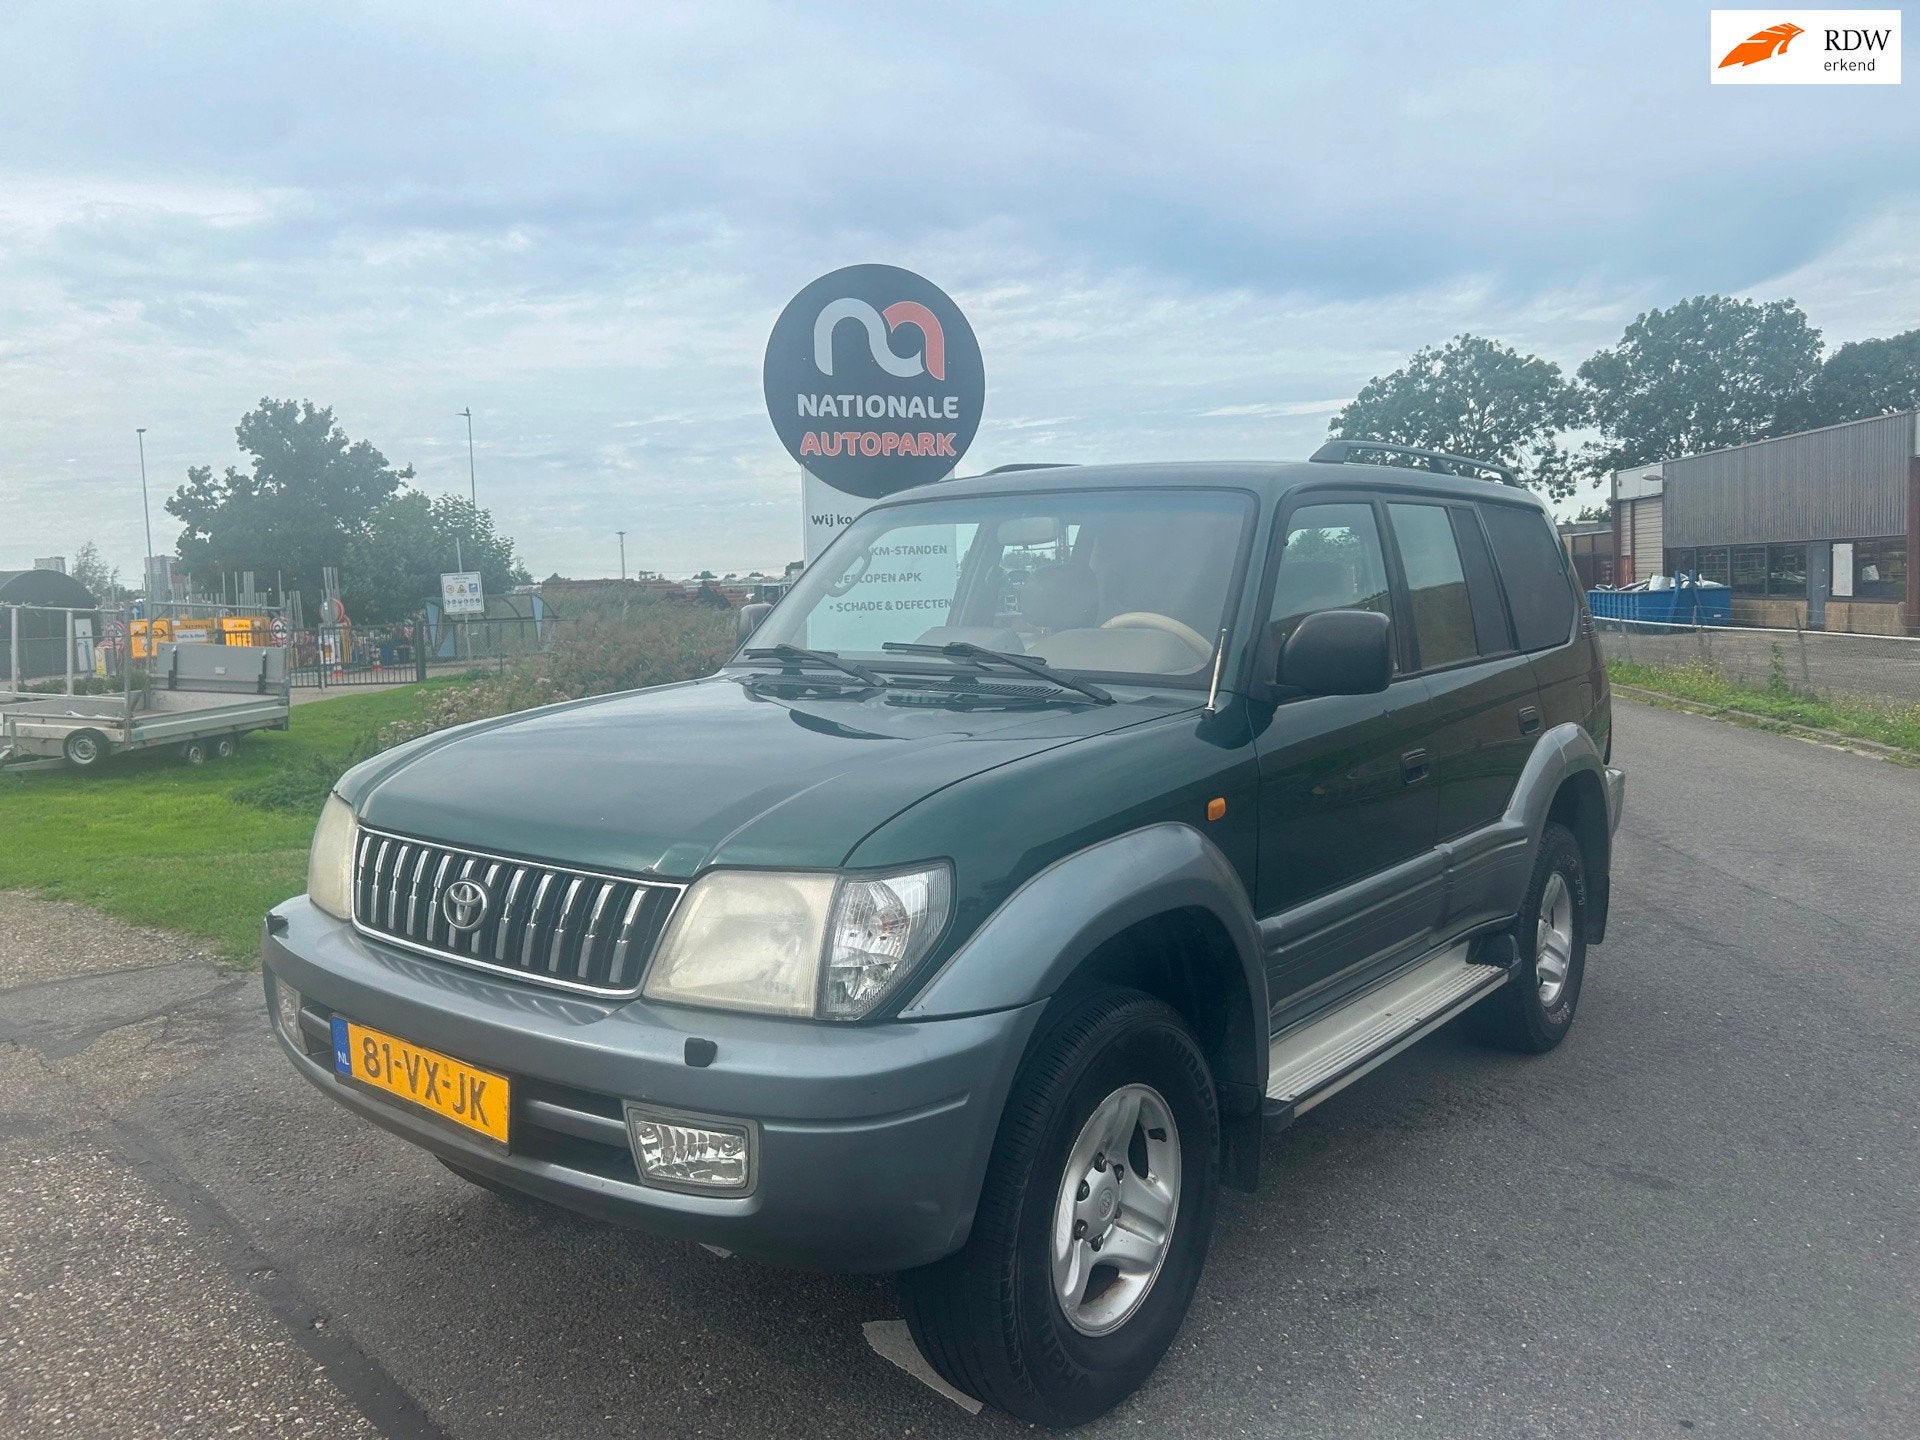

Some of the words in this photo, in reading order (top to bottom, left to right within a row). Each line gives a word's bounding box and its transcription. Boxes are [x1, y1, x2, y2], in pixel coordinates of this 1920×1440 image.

[797, 393, 959, 419] NATIONALE
[800, 431, 957, 457] AUTOPARK
[811, 513, 834, 527] Wij
[836, 514, 856, 525] ko
[870, 545, 948, 556] KM-STANDEN
[898, 572, 922, 583] APK
[836, 602, 884, 613] SCHADE
[885, 601, 894, 612] &
[895, 598, 952, 611] DEFECTEN
[337, 1051, 350, 1066] NL
[362, 1036, 490, 1127] 81-VX-JK
